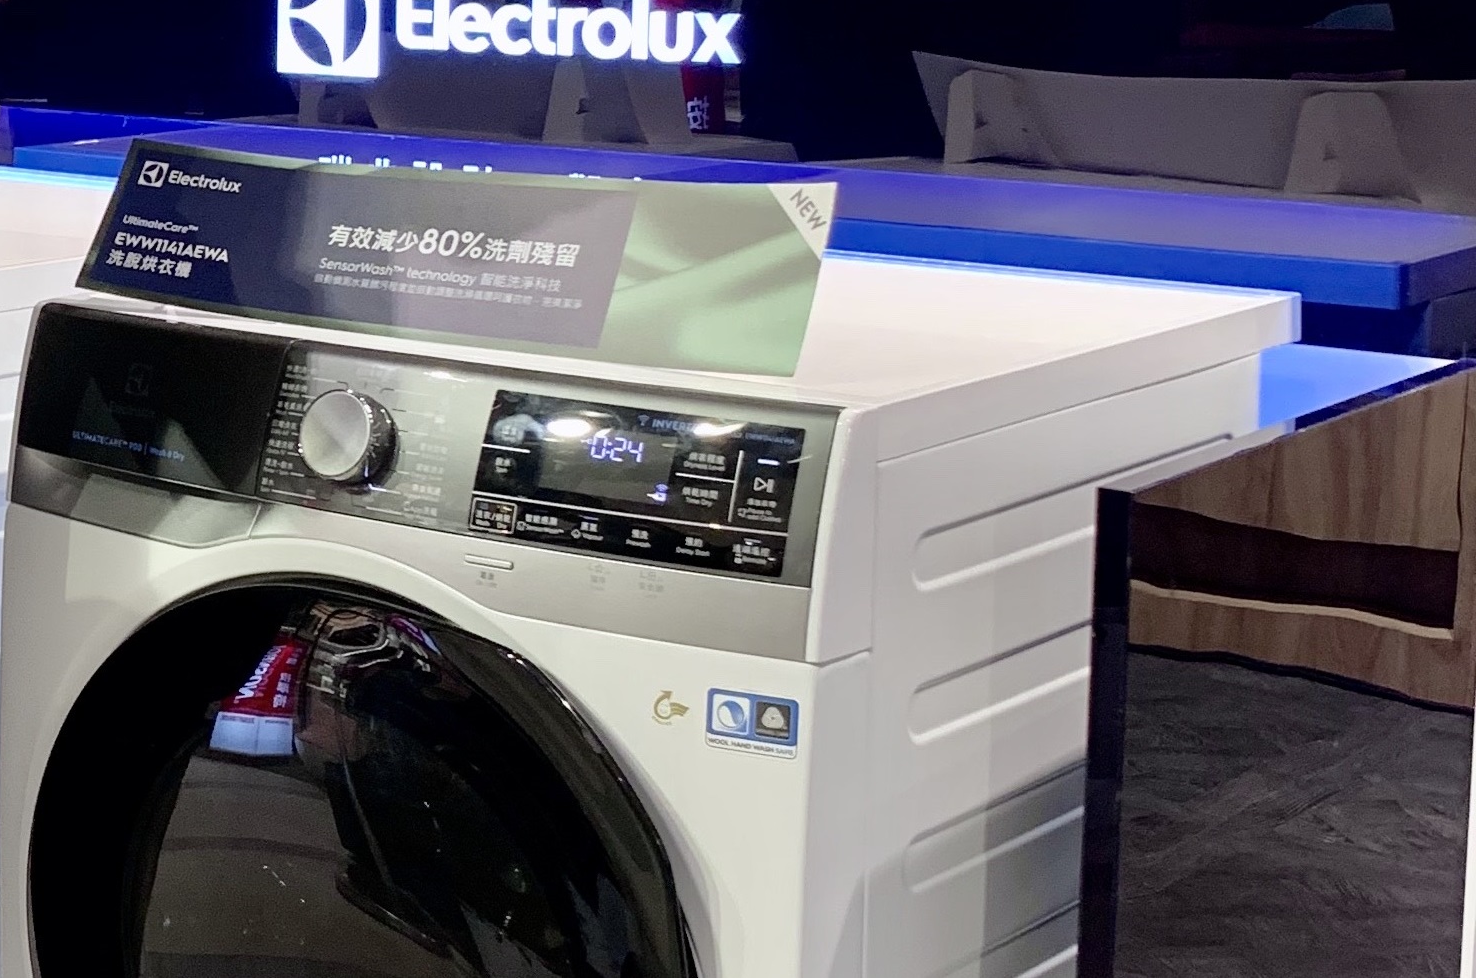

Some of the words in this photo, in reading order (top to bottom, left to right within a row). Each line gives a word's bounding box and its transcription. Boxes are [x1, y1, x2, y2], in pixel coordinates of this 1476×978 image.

[167, 169, 243, 194] Electrolux
[789, 188, 828, 231] NEW
[113, 231, 230, 263] EWW1141AEWA
[406, 266, 478, 287] technology
